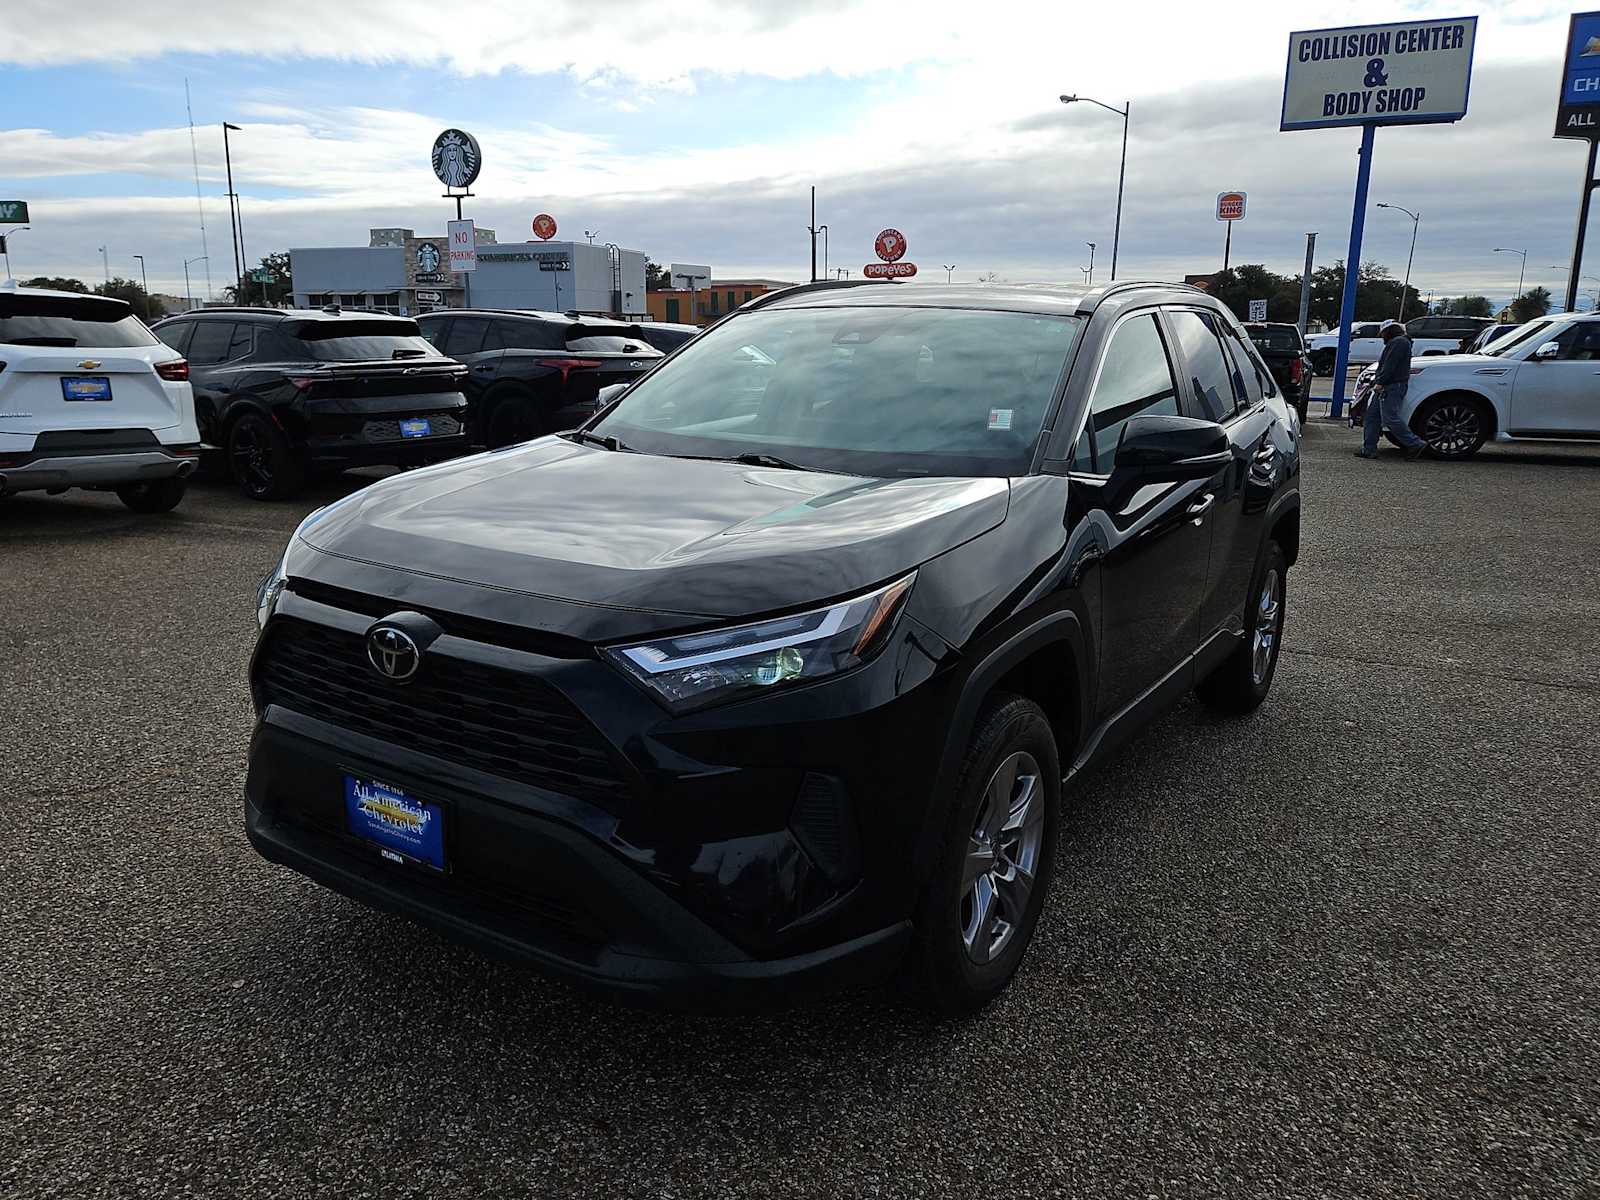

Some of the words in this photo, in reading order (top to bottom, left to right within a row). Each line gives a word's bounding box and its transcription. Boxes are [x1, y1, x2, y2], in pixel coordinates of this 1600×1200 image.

[1299, 32, 1391, 62] COLLISION
[1395, 24, 1465, 54] CENTER
[1363, 58, 1389, 88] &
[1322, 90, 1373, 117] BODY
[1375, 87, 1426, 113] SHOP
[1567, 113, 1596, 127] ALL
[1219, 206, 1243, 214] KING
[455, 232, 468, 244] NO
[450, 250, 474, 261] PARKING
[1251, 311, 1265, 319] 35
[353, 780, 369, 800] All
[371, 791, 431, 821] American
[362, 803, 424, 835] Chevrolet
